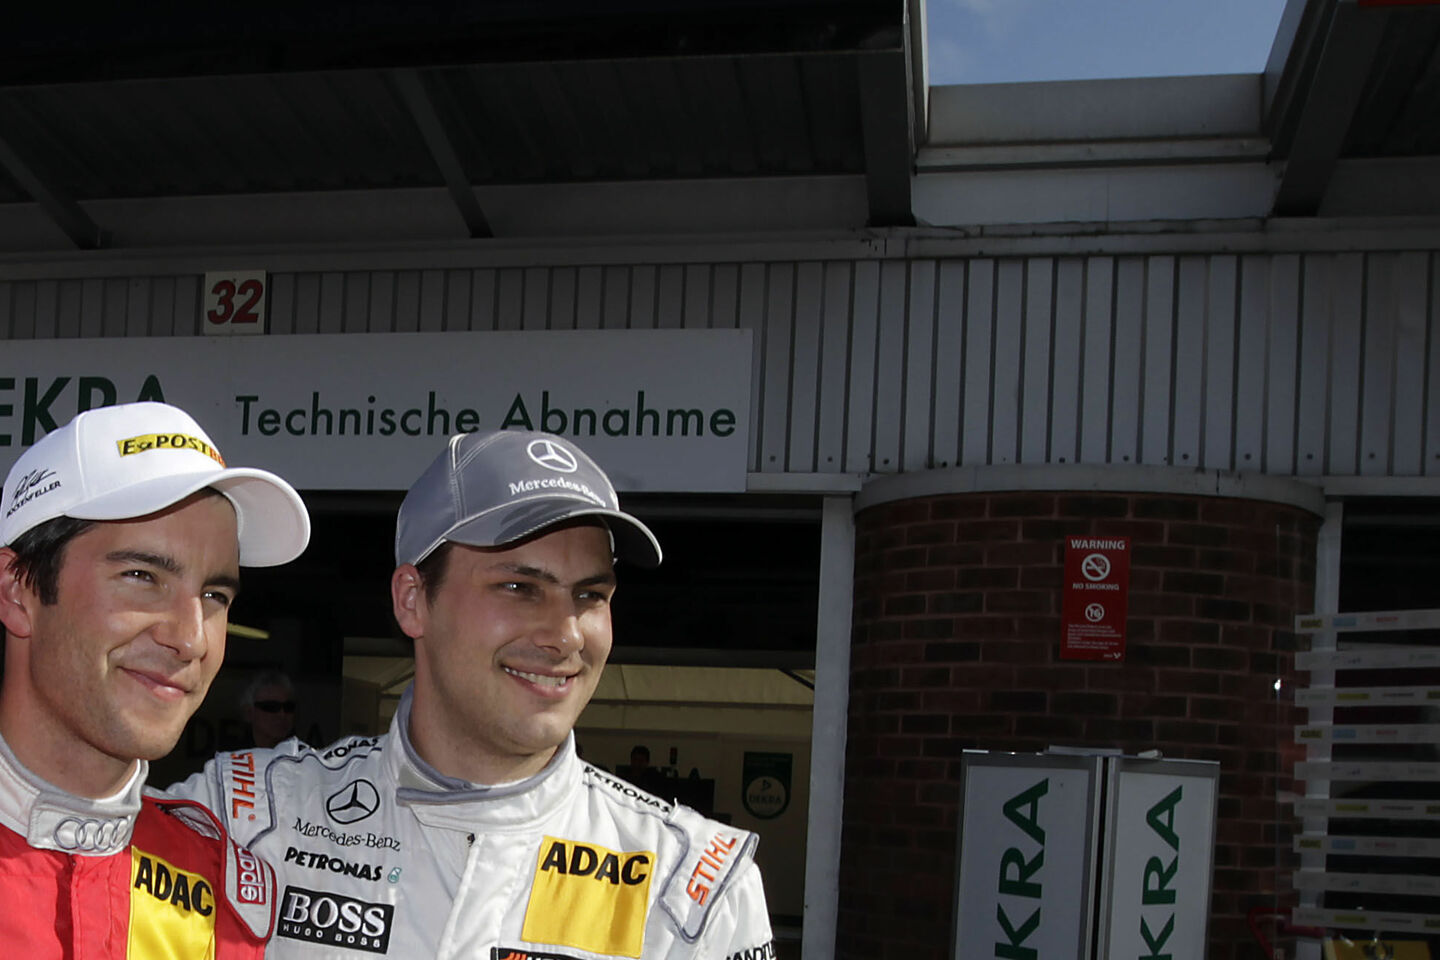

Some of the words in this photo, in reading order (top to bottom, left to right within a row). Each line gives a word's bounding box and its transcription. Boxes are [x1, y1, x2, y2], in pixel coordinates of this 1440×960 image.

[206, 278, 263, 324] 32
[236, 391, 480, 436] Technische
[500, 391, 736, 436] Abnahme
[1071, 539, 1126, 551] WARNING
[1072, 582, 1084, 591] NO
[1085, 582, 1120, 591] SMOKING
[1089, 607, 1101, 618] 16
[230, 752, 255, 819] STIHL
[583, 765, 672, 814] PETRONAS
[292, 817, 401, 852] Mercedes-Benz
[284, 846, 383, 881] PETRONAS
[541, 842, 650, 886] ADAC
[686, 832, 737, 906] STIHL
[134, 855, 214, 917] ADAC
[283, 892, 386, 937] BOSS
[283, 924, 323, 938] HUGO
[335, 933, 380, 948] BOSS
